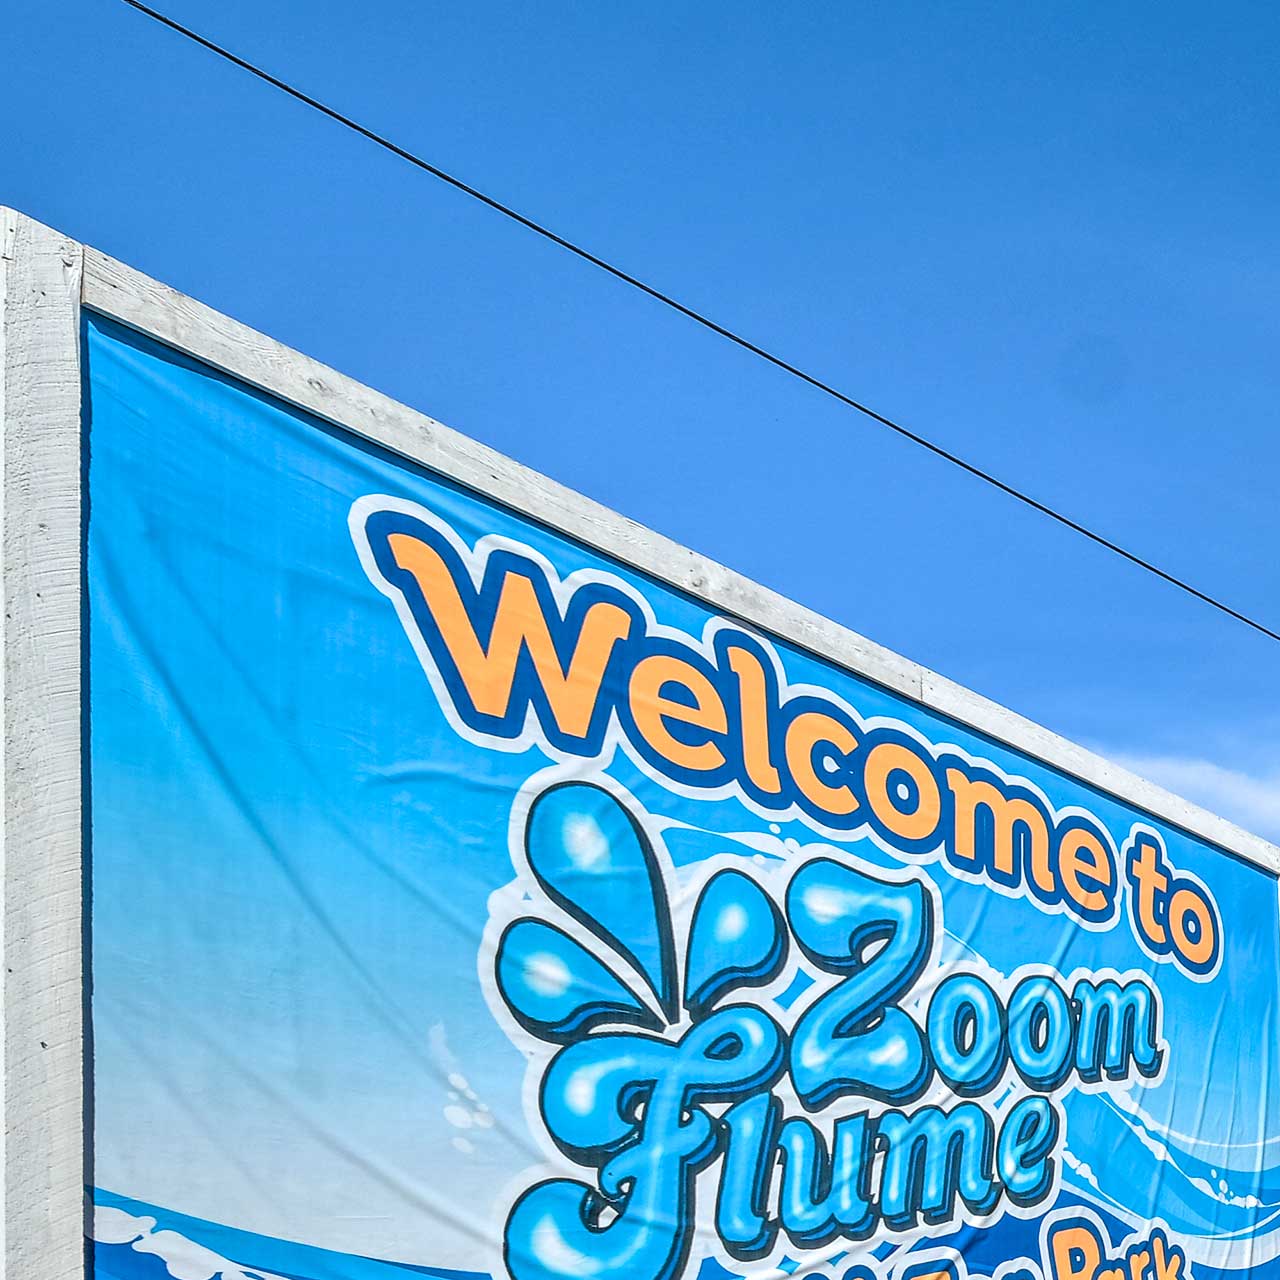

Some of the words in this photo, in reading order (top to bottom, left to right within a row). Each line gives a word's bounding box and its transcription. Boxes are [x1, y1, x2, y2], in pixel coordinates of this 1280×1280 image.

[366, 511, 1117, 923] Welcome
[1128, 832, 1218, 974] to
[786, 858, 1163, 1108] Zoom
